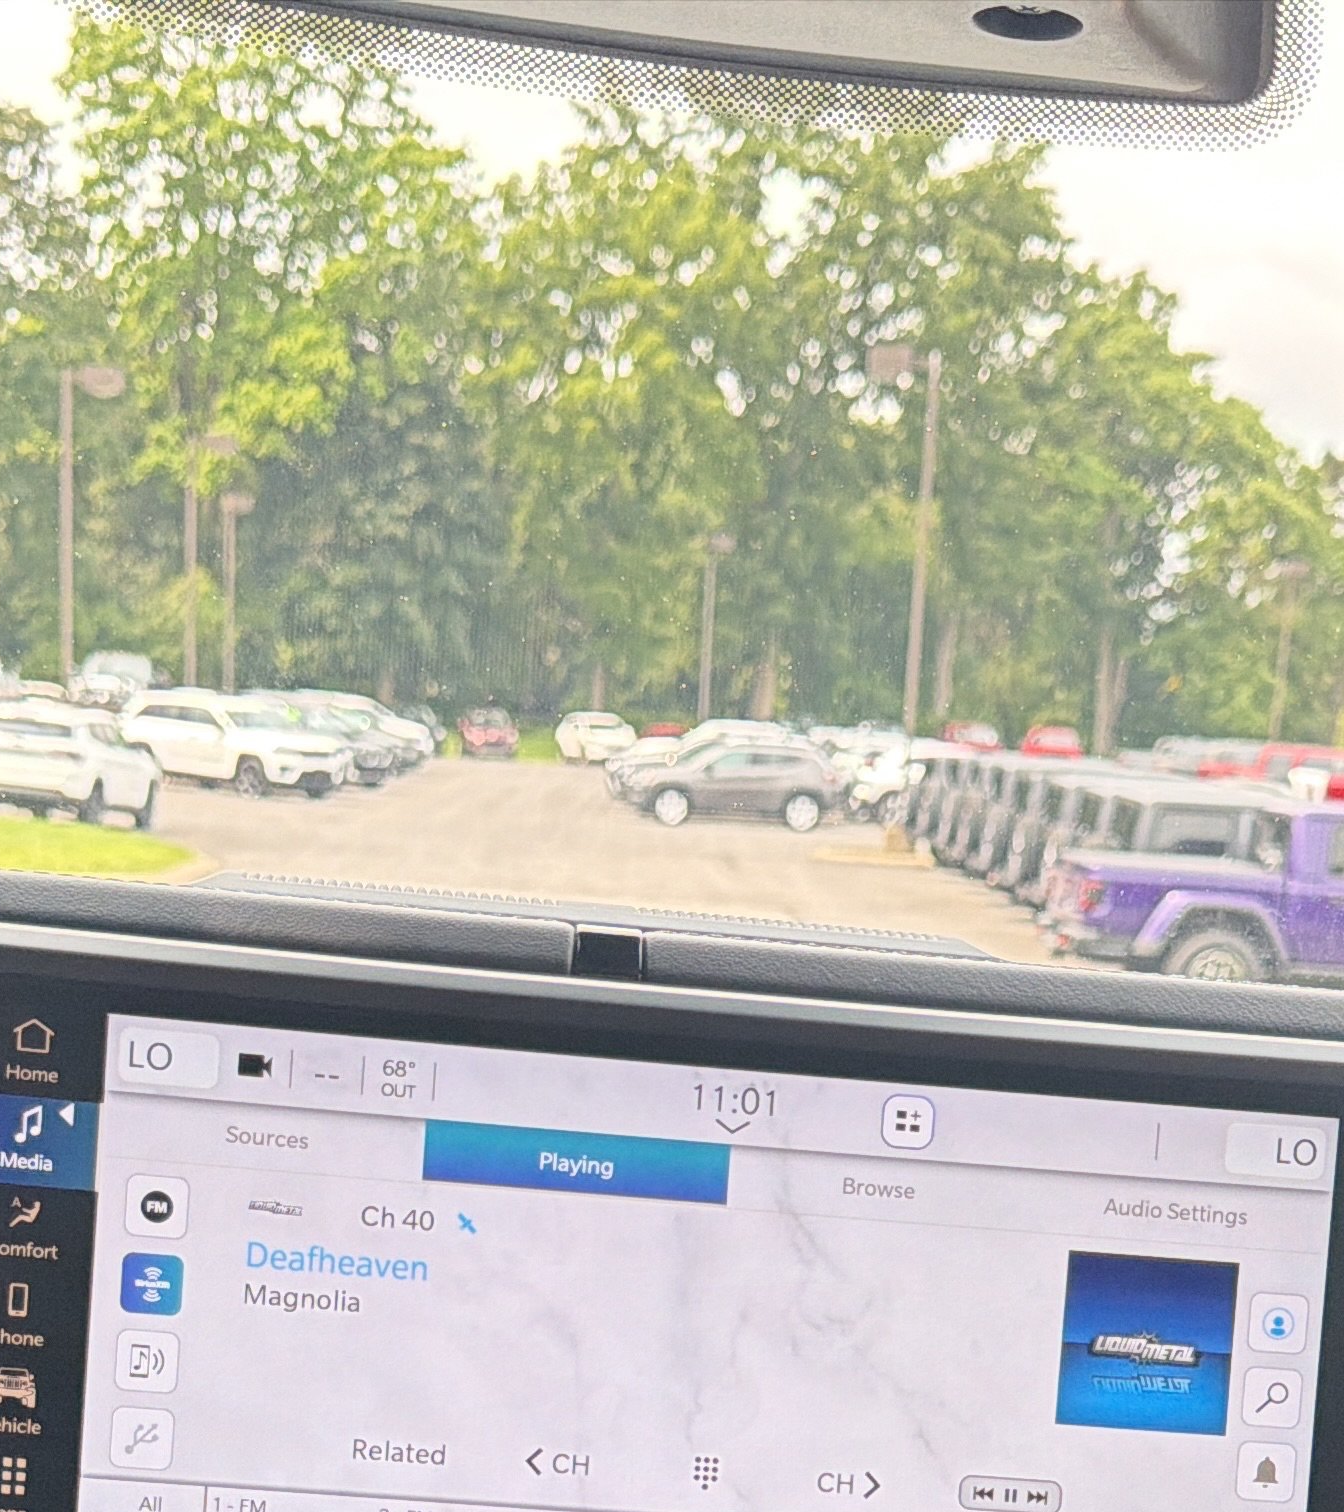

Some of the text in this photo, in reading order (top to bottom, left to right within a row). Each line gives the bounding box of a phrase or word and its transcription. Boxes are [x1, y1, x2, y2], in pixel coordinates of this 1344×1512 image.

[128, 1040, 173, 1071] LO
[6, 1064, 59, 1083] Home
[382, 1060, 416, 1078] 68°
[381, 1083, 416, 1098] OUT
[693, 1084, 777, 1116] 11:01
[226, 1126, 308, 1150] Sources
[0, 1152, 53, 1172] Media
[1276, 1138, 1318, 1166] LO
[538, 1152, 614, 1180] Playing
[842, 1178, 916, 1200] Browse
[146, 1201, 168, 1214] FM
[361, 1206, 434, 1232] Ch 40
[1104, 1198, 1248, 1226] Audio Settings
[247, 1241, 428, 1281] Deafheaven
[244, 1284, 361, 1312] Magnolia
[352, 1438, 446, 1466] Related
[552, 1455, 590, 1476] CH
[817, 1472, 854, 1494] CH
[138, 1497, 162, 1512] All
[214, 1498, 221, 1512] 1
